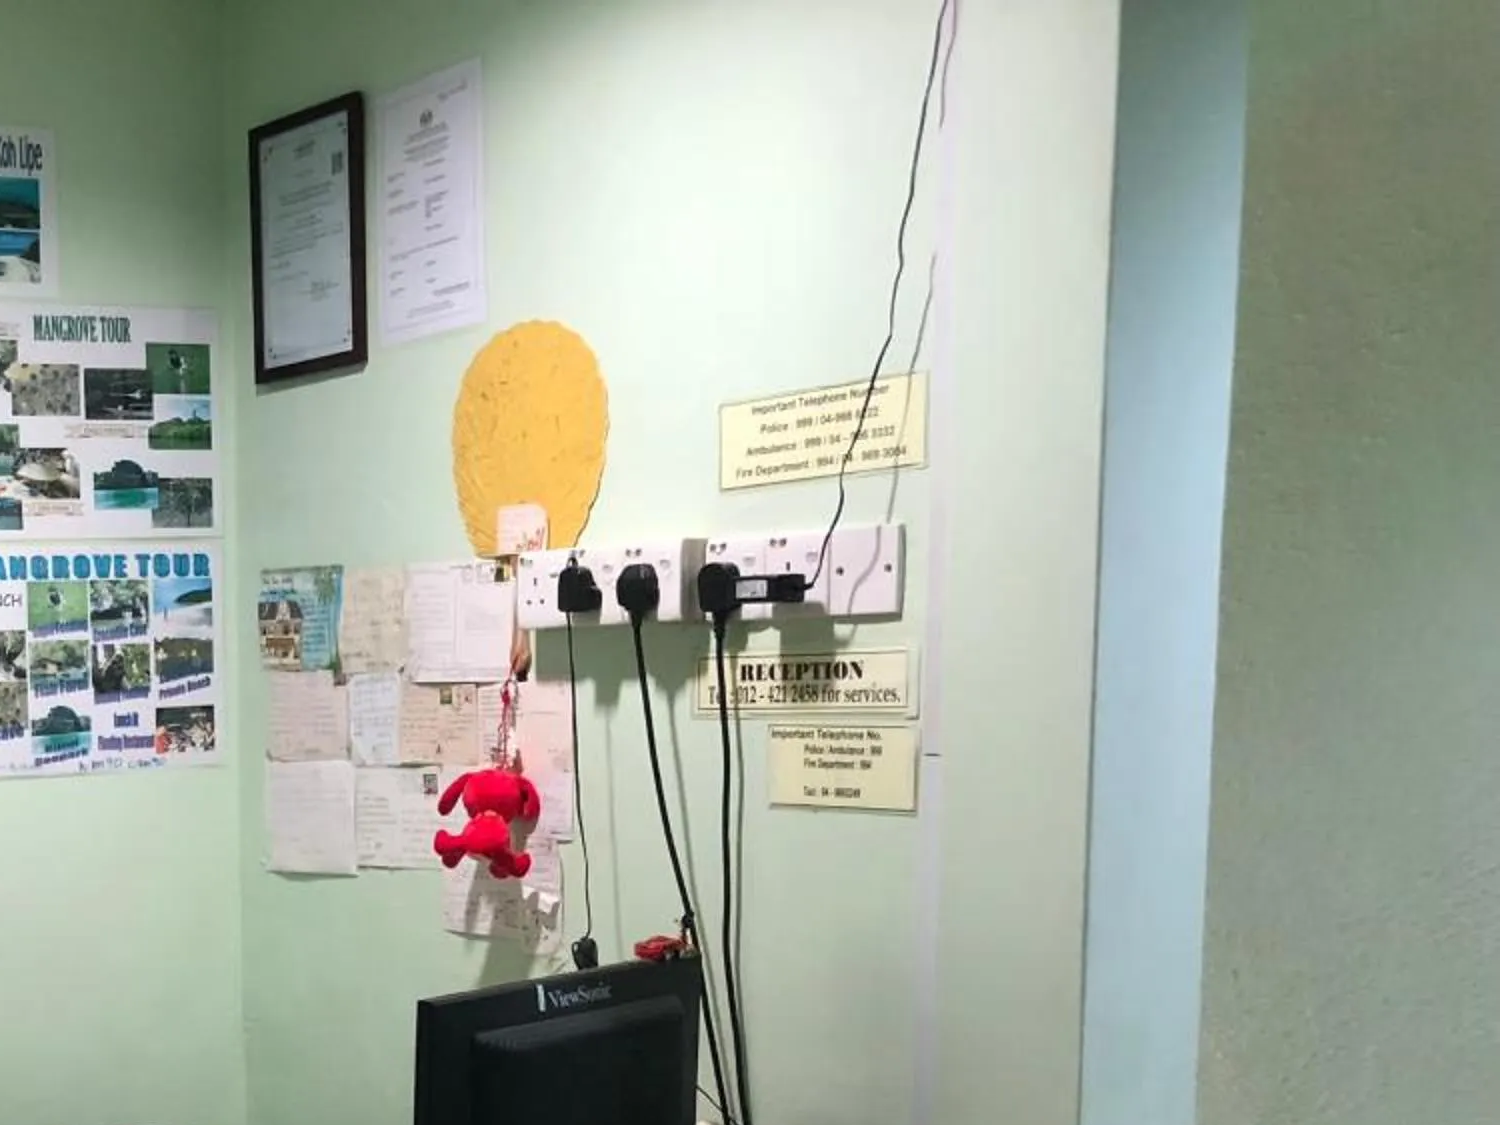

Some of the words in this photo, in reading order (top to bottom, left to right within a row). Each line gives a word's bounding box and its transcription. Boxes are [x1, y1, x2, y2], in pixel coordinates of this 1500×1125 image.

[19, 136, 43, 175] Lipe
[33, 315, 97, 342] MANGROVE
[100, 317, 132, 343] TOUR
[135, 553, 210, 578] TOUR
[740, 660, 864, 681] RECEPTION
[822, 683, 840, 703] for
[843, 683, 901, 704] services.
[548, 982, 613, 1008] ViewSonic
